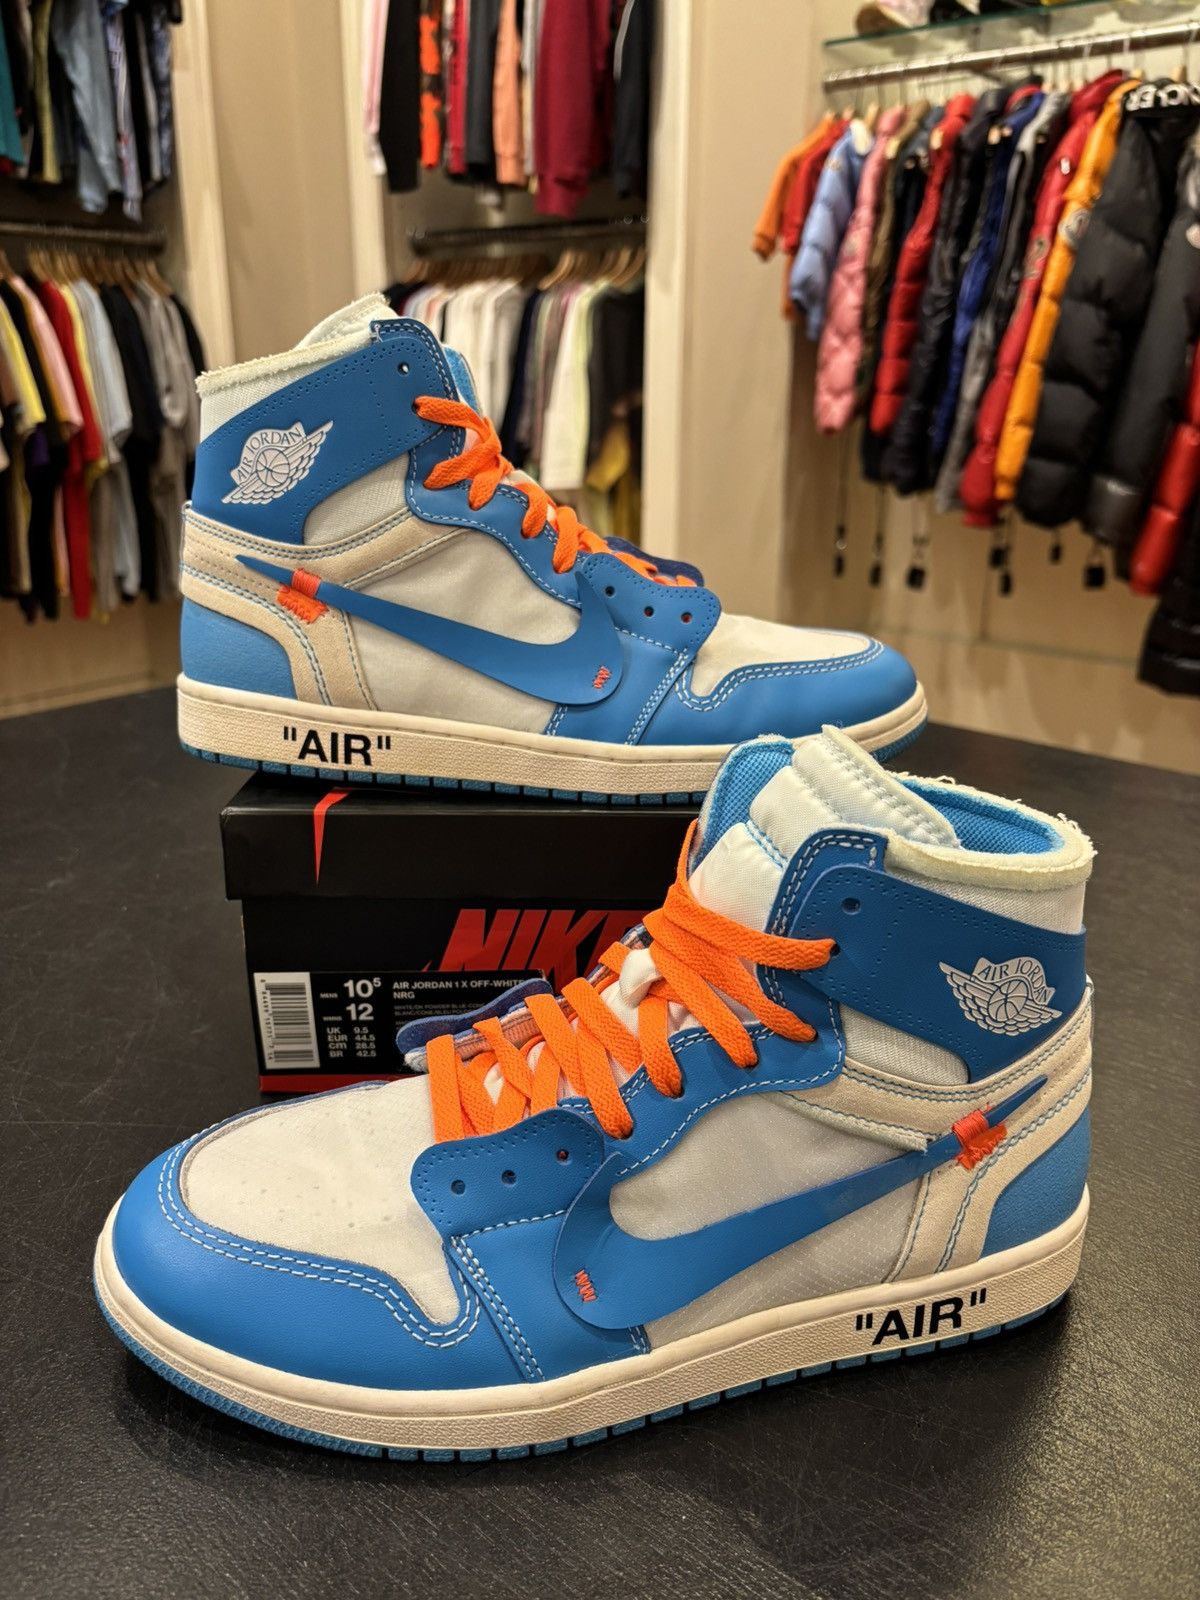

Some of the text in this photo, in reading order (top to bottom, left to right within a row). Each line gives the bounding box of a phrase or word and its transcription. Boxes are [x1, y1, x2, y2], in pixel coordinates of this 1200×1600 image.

[237, 427, 302, 480] AIR JORDAN
[283, 726, 391, 766] "AIR"
[392, 981, 410, 990] AIR
[411, 981, 451, 989] JORDAN
[454, 980, 459, 988] 1
[461, 980, 469, 988] X
[393, 991, 415, 999] NRG
[977, 959, 1047, 1002] AIR JORDAN
[346, 1003, 374, 1020] 12
[856, 1288, 986, 1345] "AIR"
